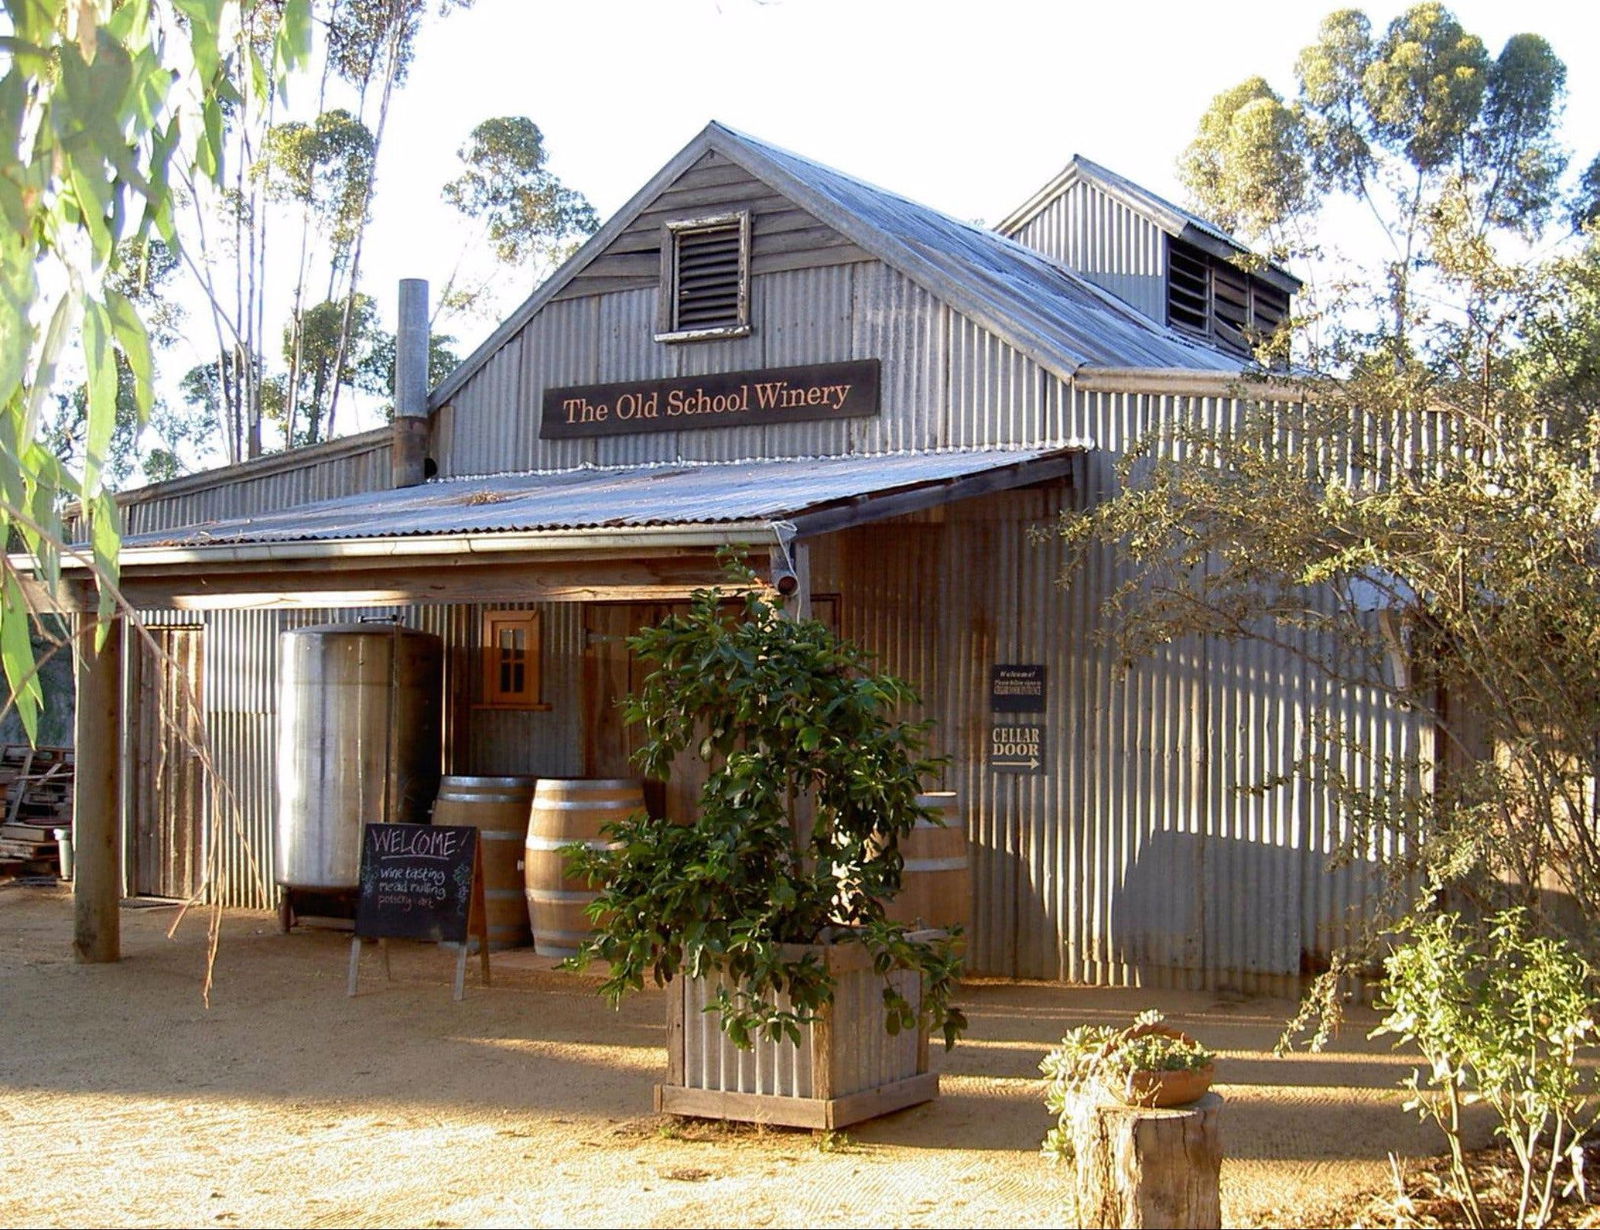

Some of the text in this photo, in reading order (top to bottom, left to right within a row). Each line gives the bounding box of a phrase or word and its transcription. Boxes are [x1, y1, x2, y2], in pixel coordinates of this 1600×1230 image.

[563, 381, 851, 424] The Old School Winery
[992, 728, 1040, 743] CELLAR
[992, 743, 1039, 756] DOOR
[372, 828, 470, 856] WELCOME!
[381, 867, 445, 885] wine tasting
